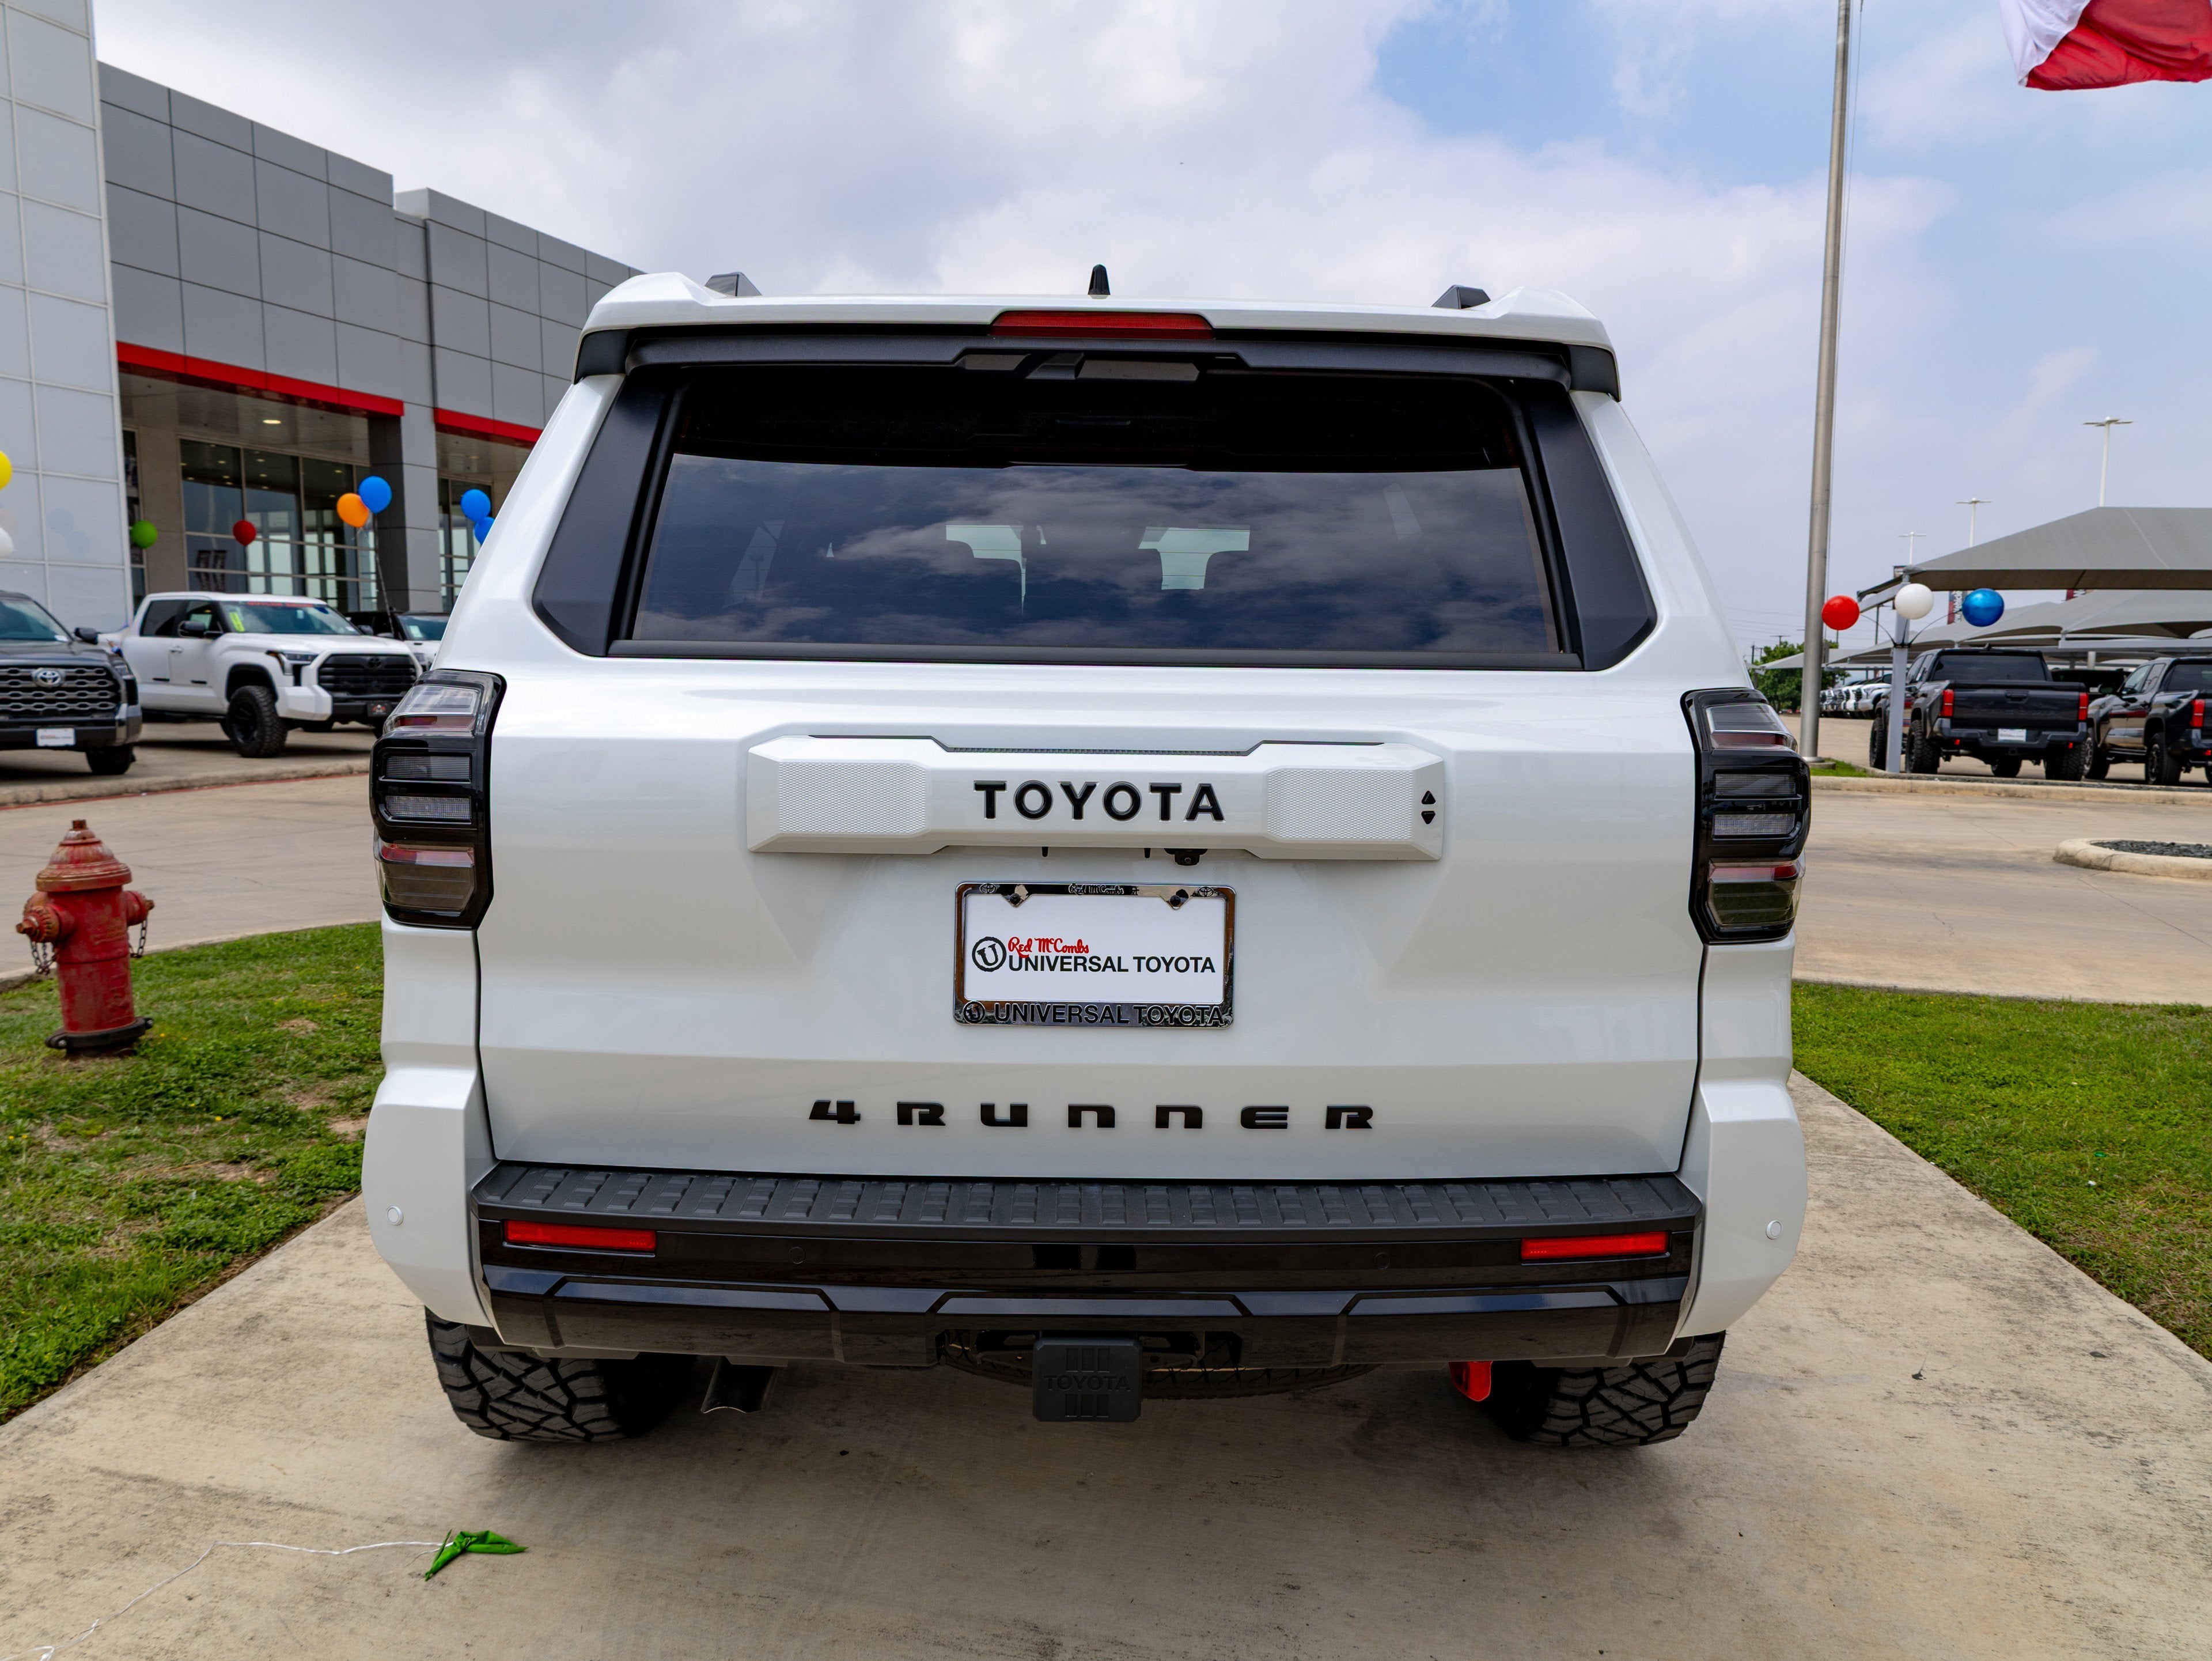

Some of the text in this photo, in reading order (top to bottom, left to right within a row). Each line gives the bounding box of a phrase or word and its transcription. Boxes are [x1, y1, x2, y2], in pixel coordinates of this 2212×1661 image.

[974, 780, 1225, 822] TOYOTA
[1069, 883, 1124, 895] Red McCombs
[1008, 936, 1090, 959] Red McCombs
[1009, 955, 1216, 973] UNIVERSAL TOYOTA
[994, 1002, 1130, 1024] UNIVERSAL
[1132, 1005, 1225, 1026] TOYOTA
[809, 1099, 1374, 1130] 4RUNNER
[1044, 1375, 1131, 1391] TOYOTA
